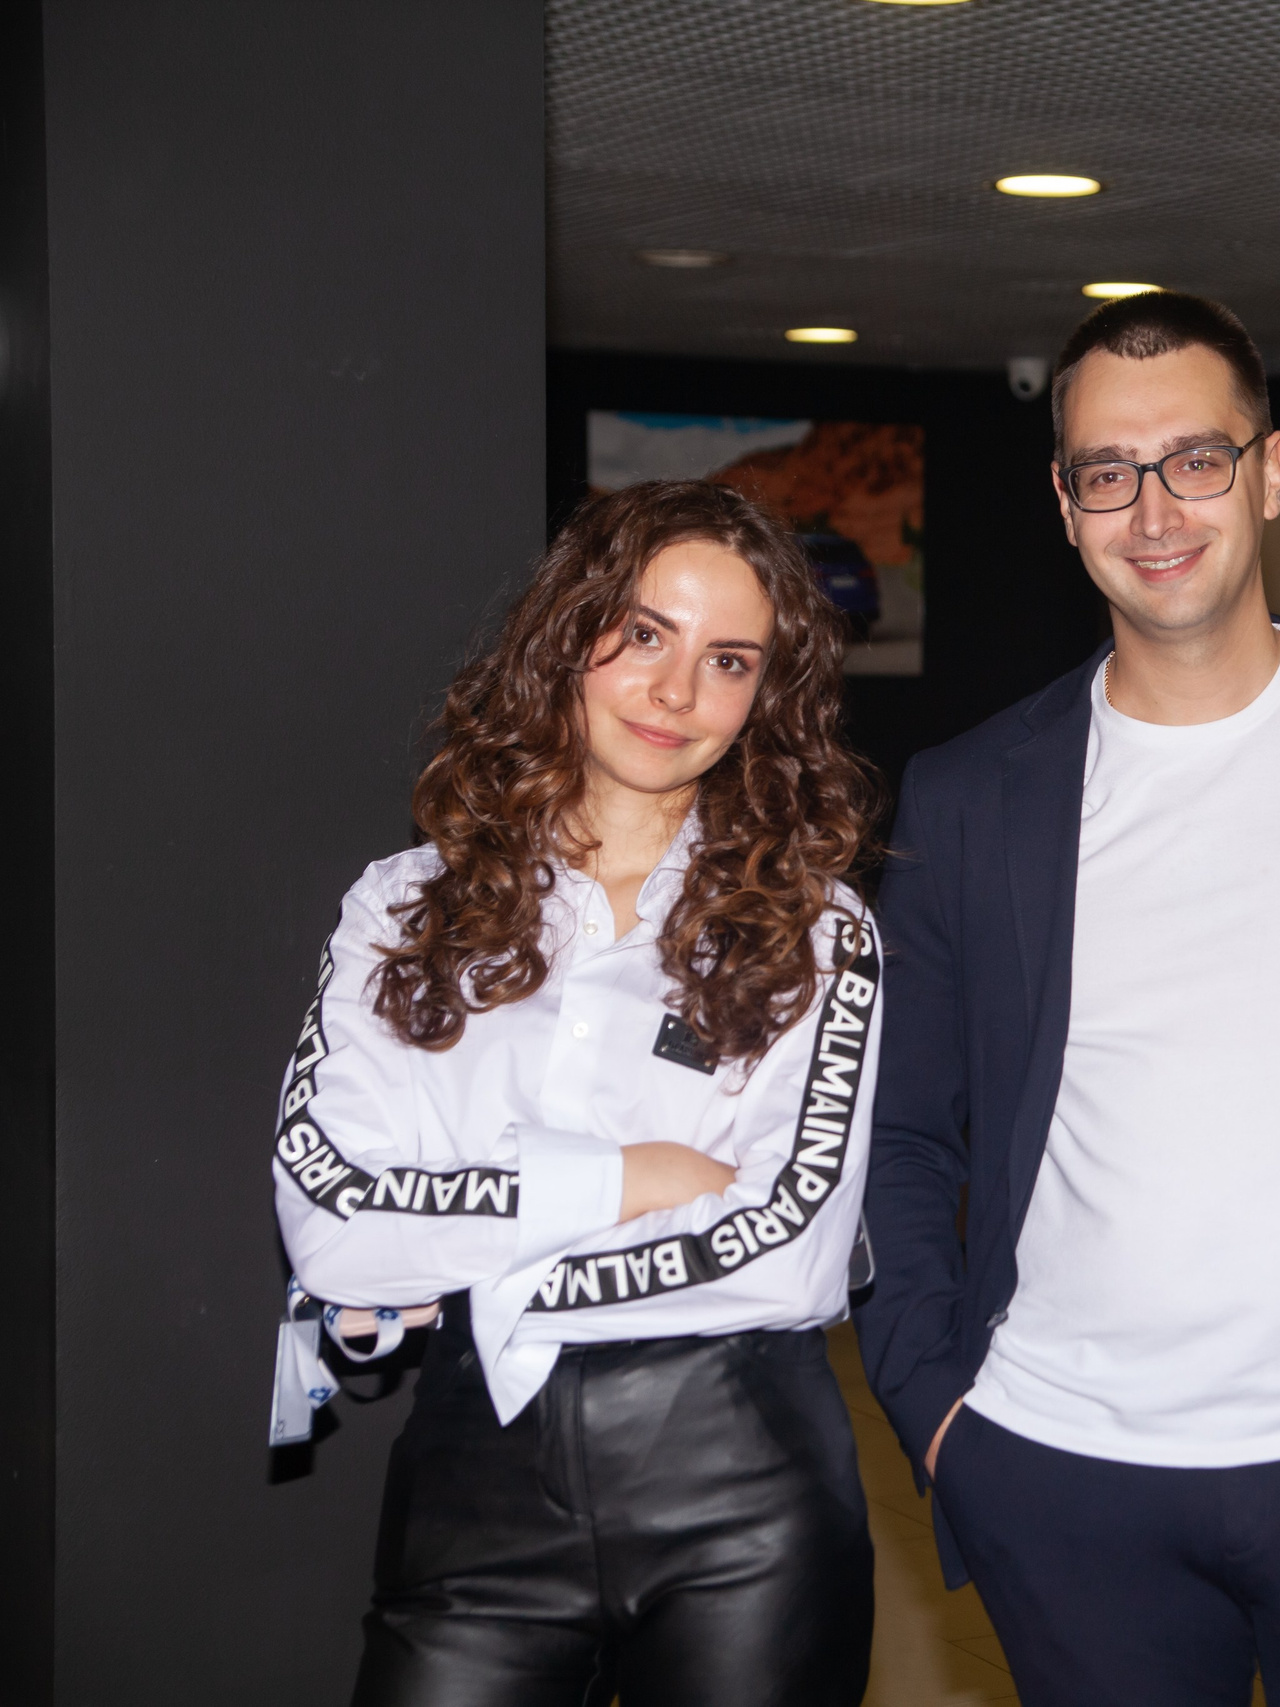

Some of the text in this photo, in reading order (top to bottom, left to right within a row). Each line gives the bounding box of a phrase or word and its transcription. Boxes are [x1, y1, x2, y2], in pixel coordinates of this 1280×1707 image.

[796, 969, 875, 1169] BALMAIN
[710, 1163, 830, 1269] PARIS
[527, 1240, 688, 1308] BALMA
